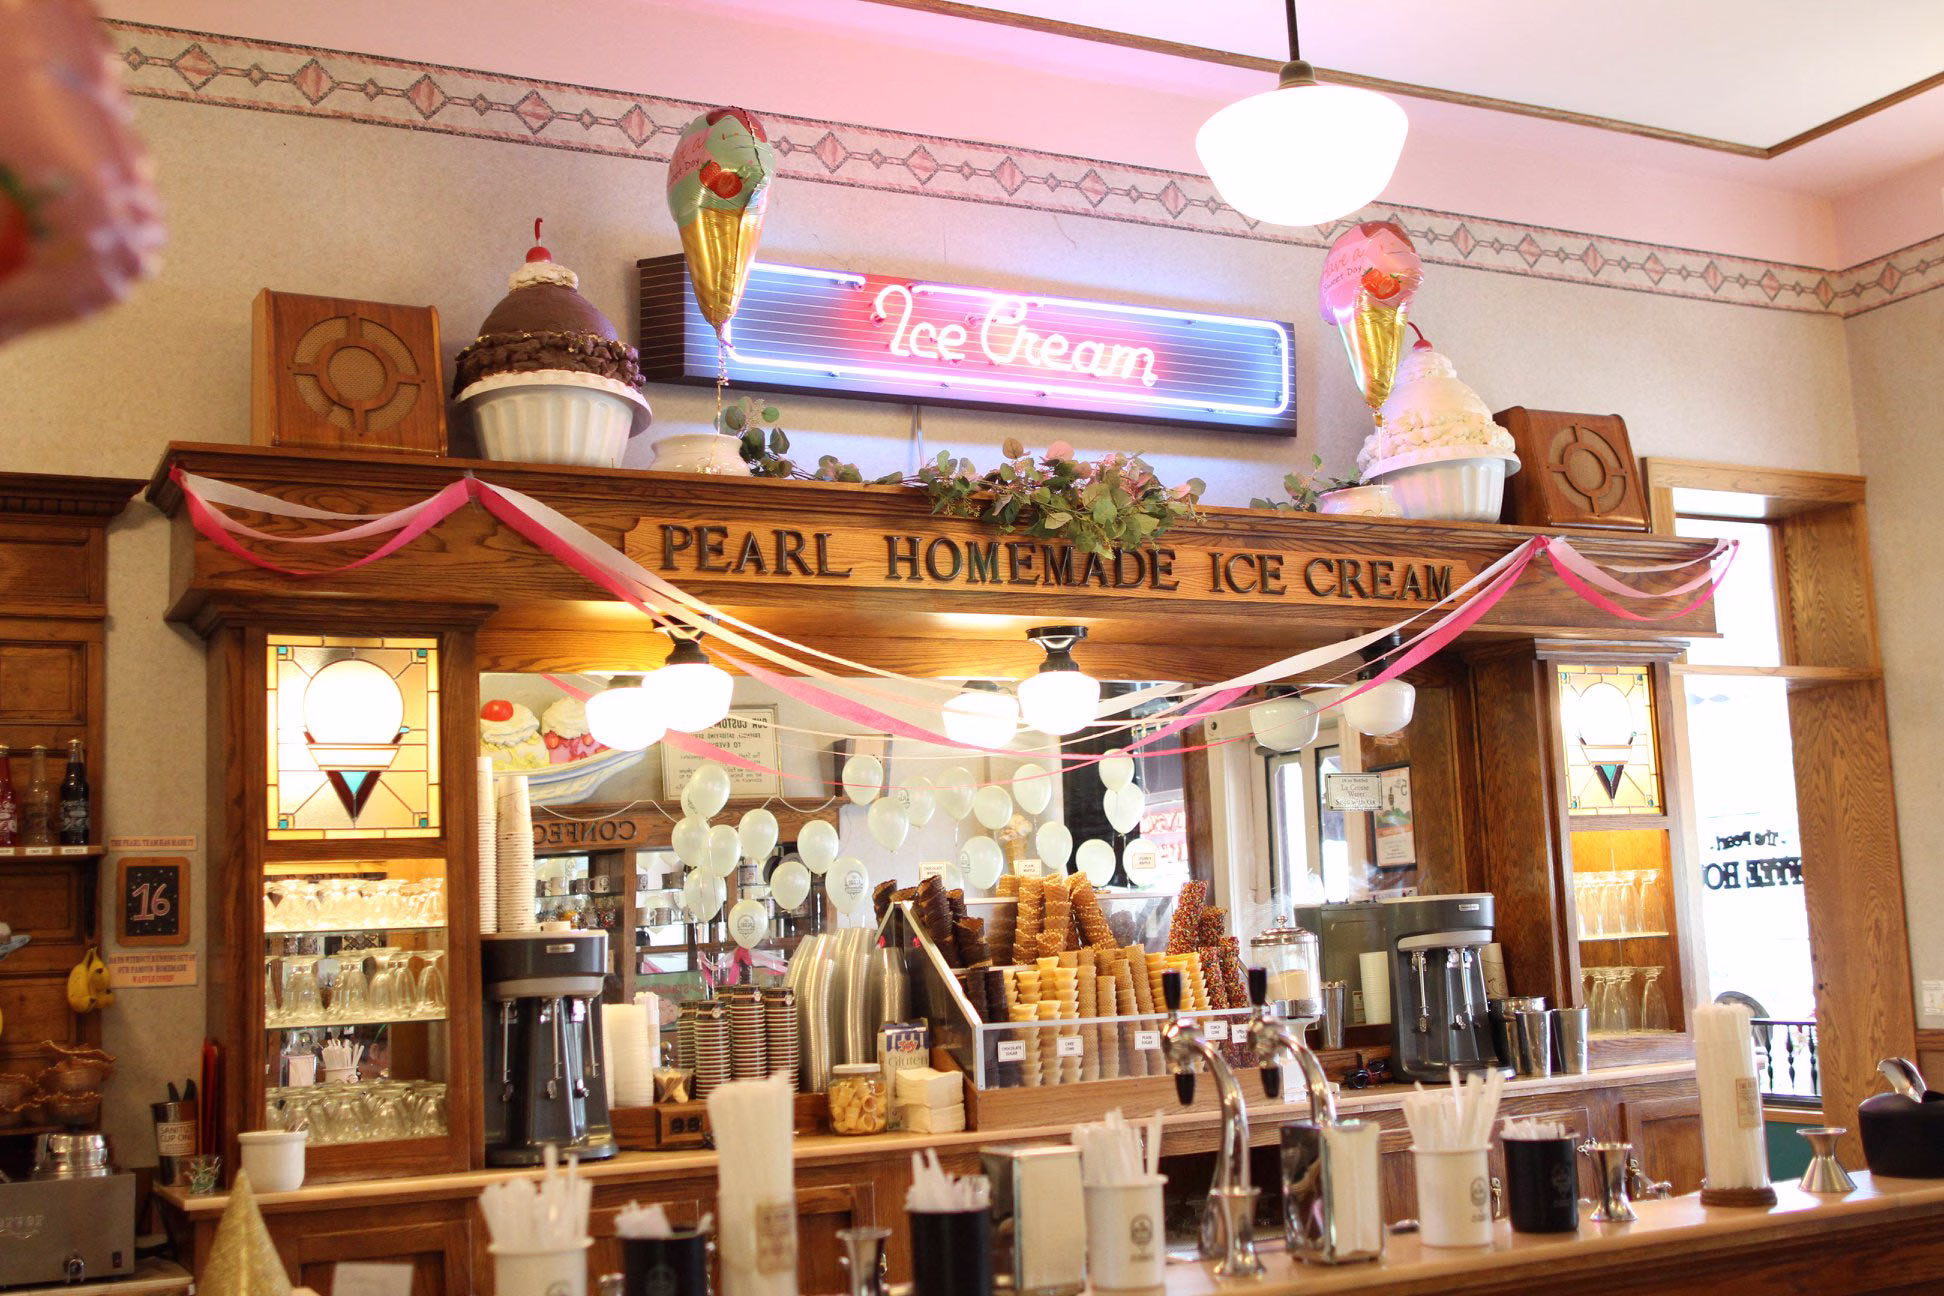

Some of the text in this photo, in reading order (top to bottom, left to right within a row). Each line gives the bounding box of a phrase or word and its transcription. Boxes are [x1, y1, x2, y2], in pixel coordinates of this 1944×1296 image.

[874, 284, 1159, 388] Ice Cream
[660, 523, 1455, 603] PEARL HOMEMADE ICE CREAM
[131, 883, 171, 921] 16
